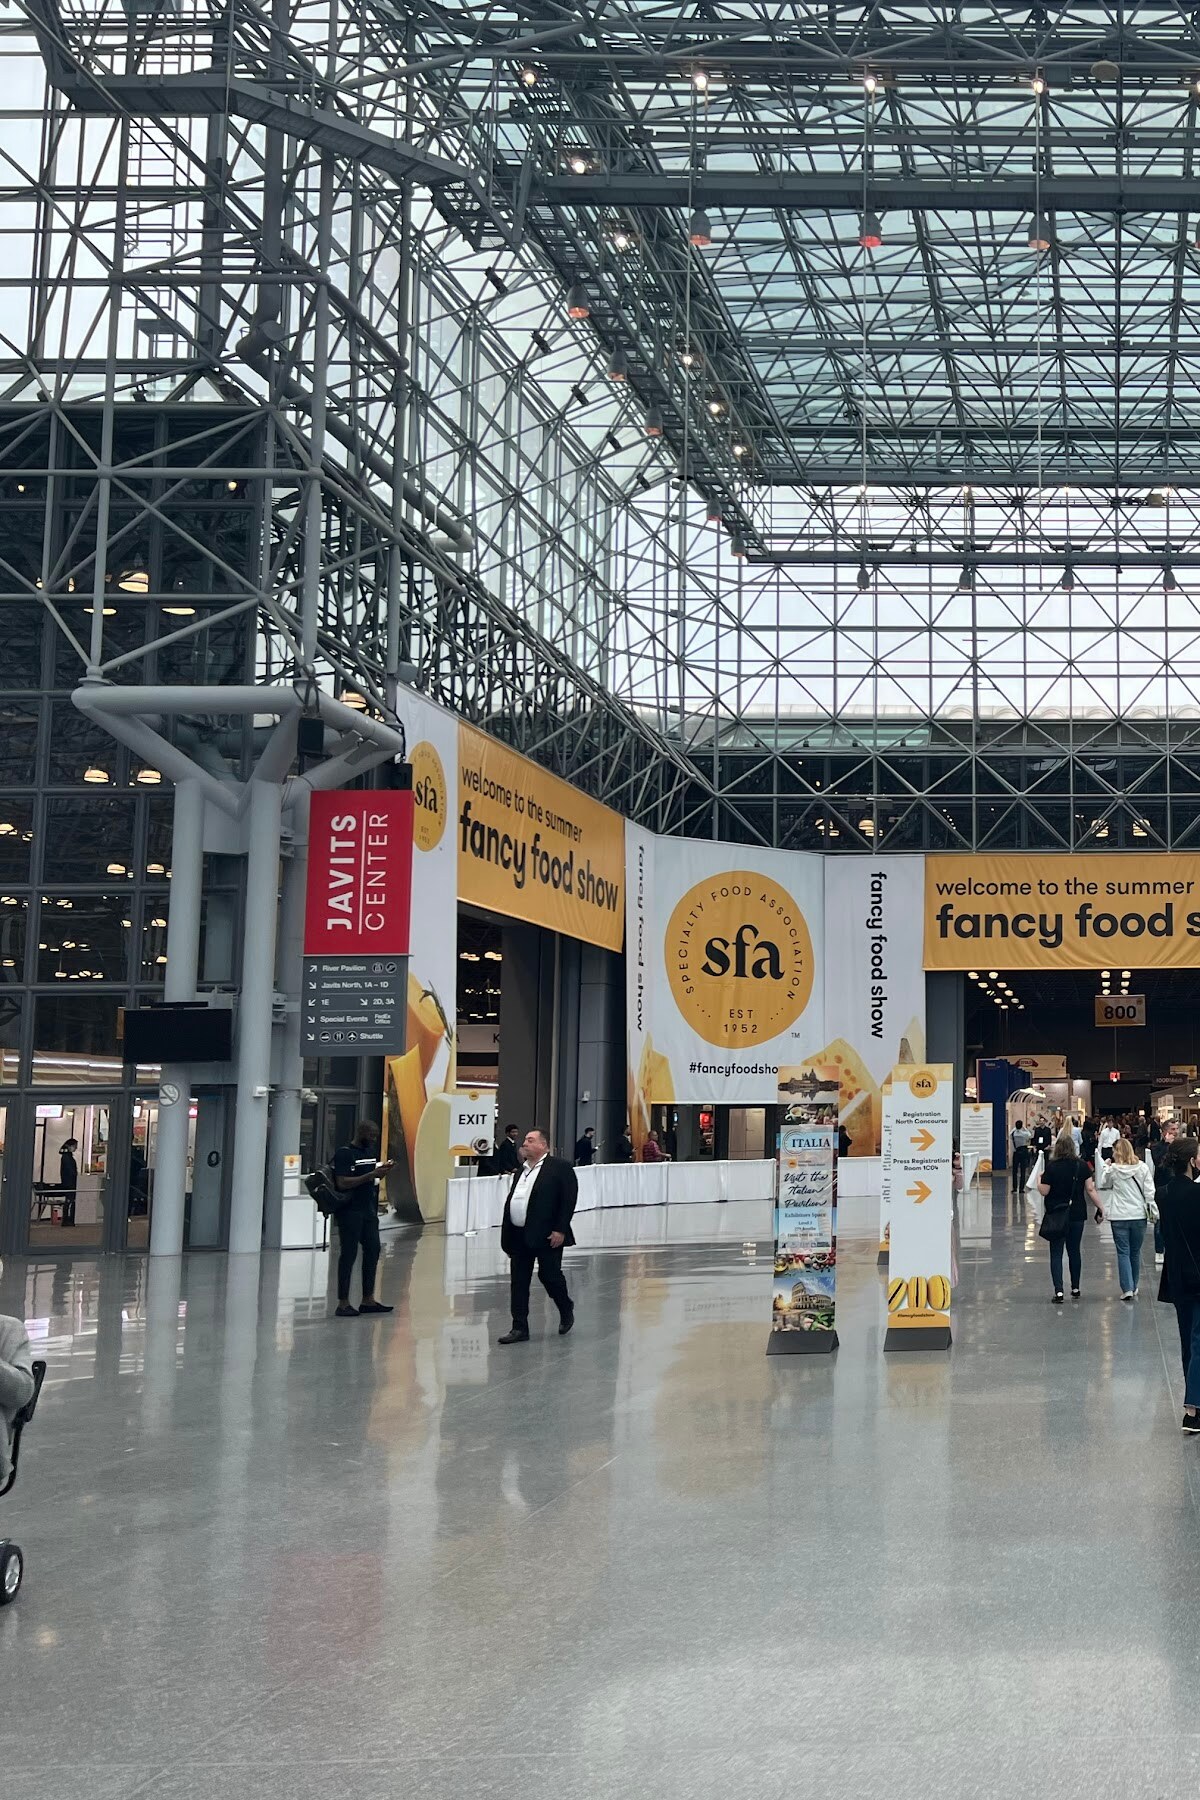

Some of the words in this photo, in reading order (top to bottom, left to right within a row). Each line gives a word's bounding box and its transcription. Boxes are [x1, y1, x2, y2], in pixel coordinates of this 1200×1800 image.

[414, 776, 438, 814] sfa
[462, 766, 512, 808] welcome
[514, 788, 525, 814] to
[528, 795, 543, 824] the
[545, 810, 583, 844] summer
[460, 800, 526, 890] fancy
[530, 832, 574, 894] food
[577, 859, 618, 912] show
[327, 814, 357, 930] JAVITS
[364, 814, 388, 931] CENTER
[935, 877, 1032, 895] welcome
[1037, 879, 1058, 895] to
[1064, 877, 1098, 895] the
[1105, 879, 1195, 895] summer
[866, 872, 888, 929] fancy
[936, 904, 1063, 949] fancy
[1074, 902, 1174, 938] food
[678, 902, 704, 994] SPECIALTY
[711, 886, 752, 902] FOOD
[760, 894, 803, 1000] ASSOCIATION
[700, 924, 786, 980] sfa
[871, 934, 888, 980] food
[729, 1009, 754, 1019] EST
[871, 986, 888, 1038] show
[1104, 1005, 1136, 1019] 800
[724, 1024, 758, 1033] 1952
[689, 1062, 778, 1076] #fancyfoodsho
[916, 1079, 931, 1088] sfa
[458, 1114, 487, 1125] EXIT
[792, 1138, 830, 1147] ITALIA
[784, 1172, 808, 1183] Visit
[810, 1171, 828, 1181] the
[788, 1185, 824, 1195] Italian
[784, 1198, 827, 1208] Pavilion
